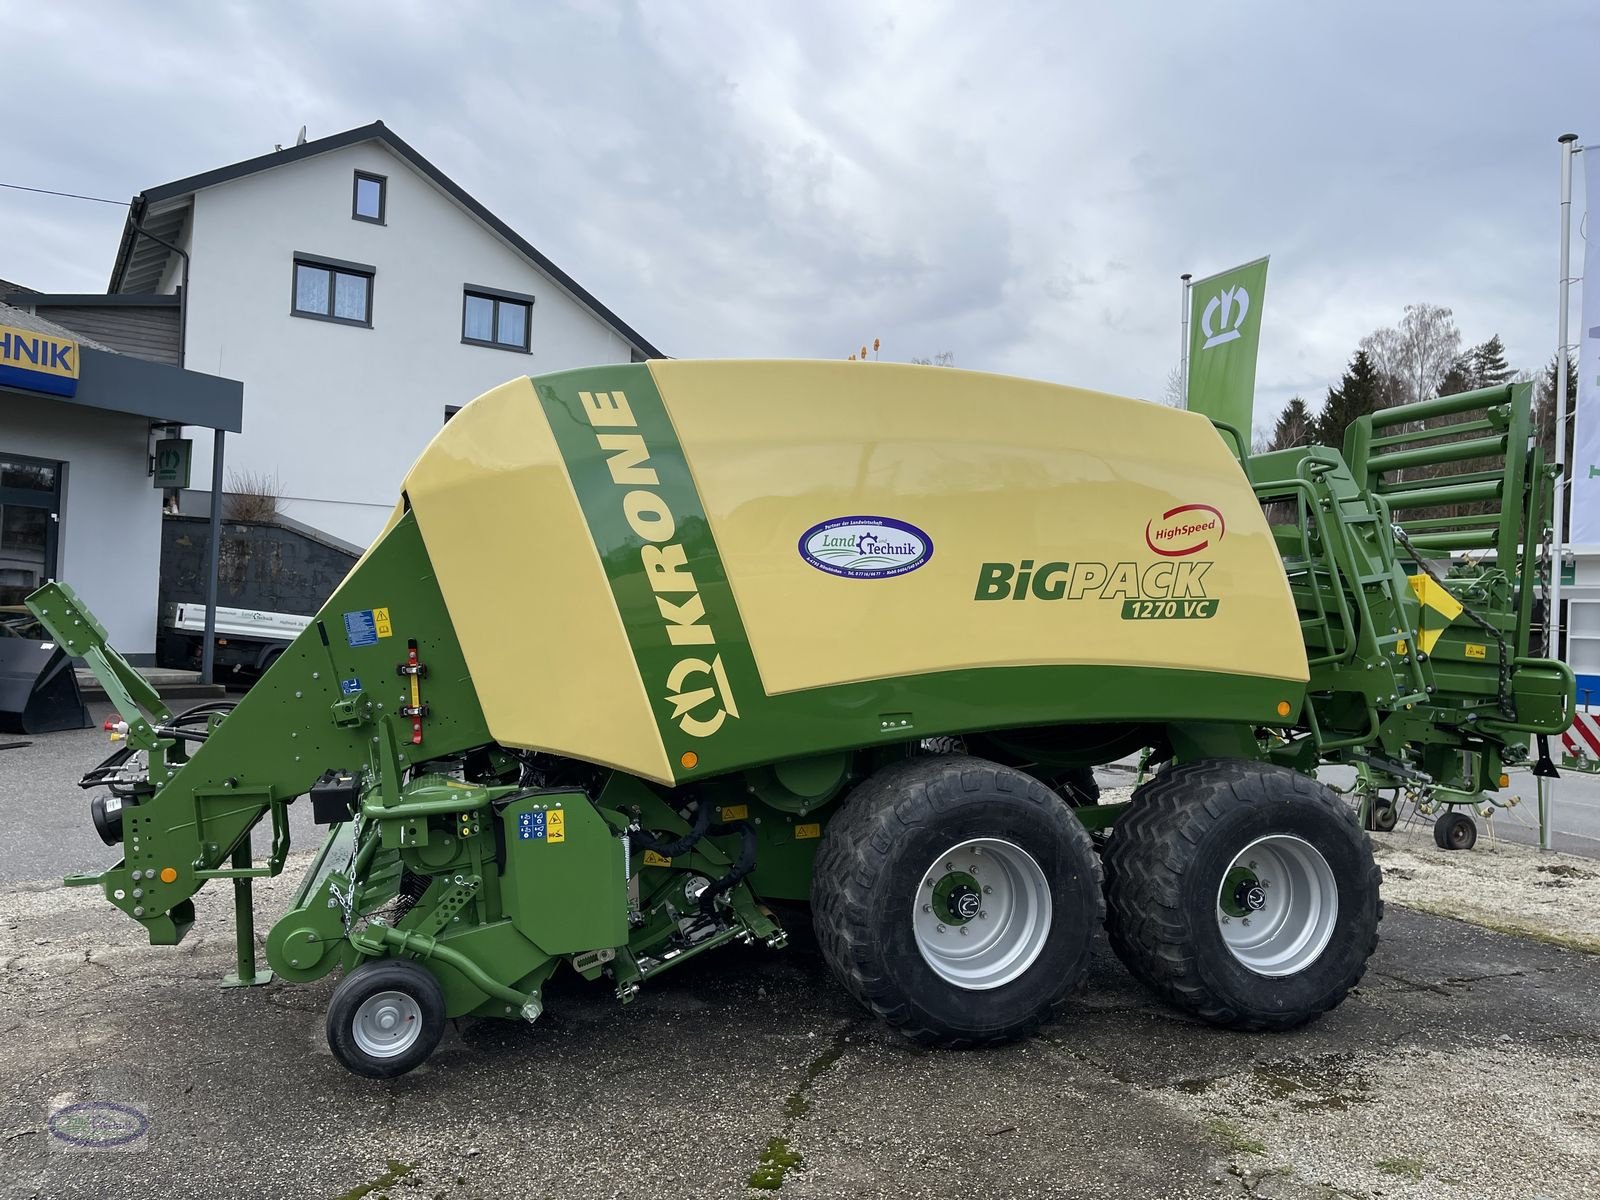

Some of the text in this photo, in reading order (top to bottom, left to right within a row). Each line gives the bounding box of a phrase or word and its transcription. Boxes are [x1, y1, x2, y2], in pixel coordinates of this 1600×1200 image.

[578, 391, 716, 645] KRONE
[824, 522, 841, 530] Partner
[1155, 519, 1216, 540] HighSpeed
[822, 534, 856, 547] Land
[867, 542, 916, 555] Technik
[974, 560, 1214, 601] BiGPACK
[1132, 601, 1210, 618] 1270 VC
